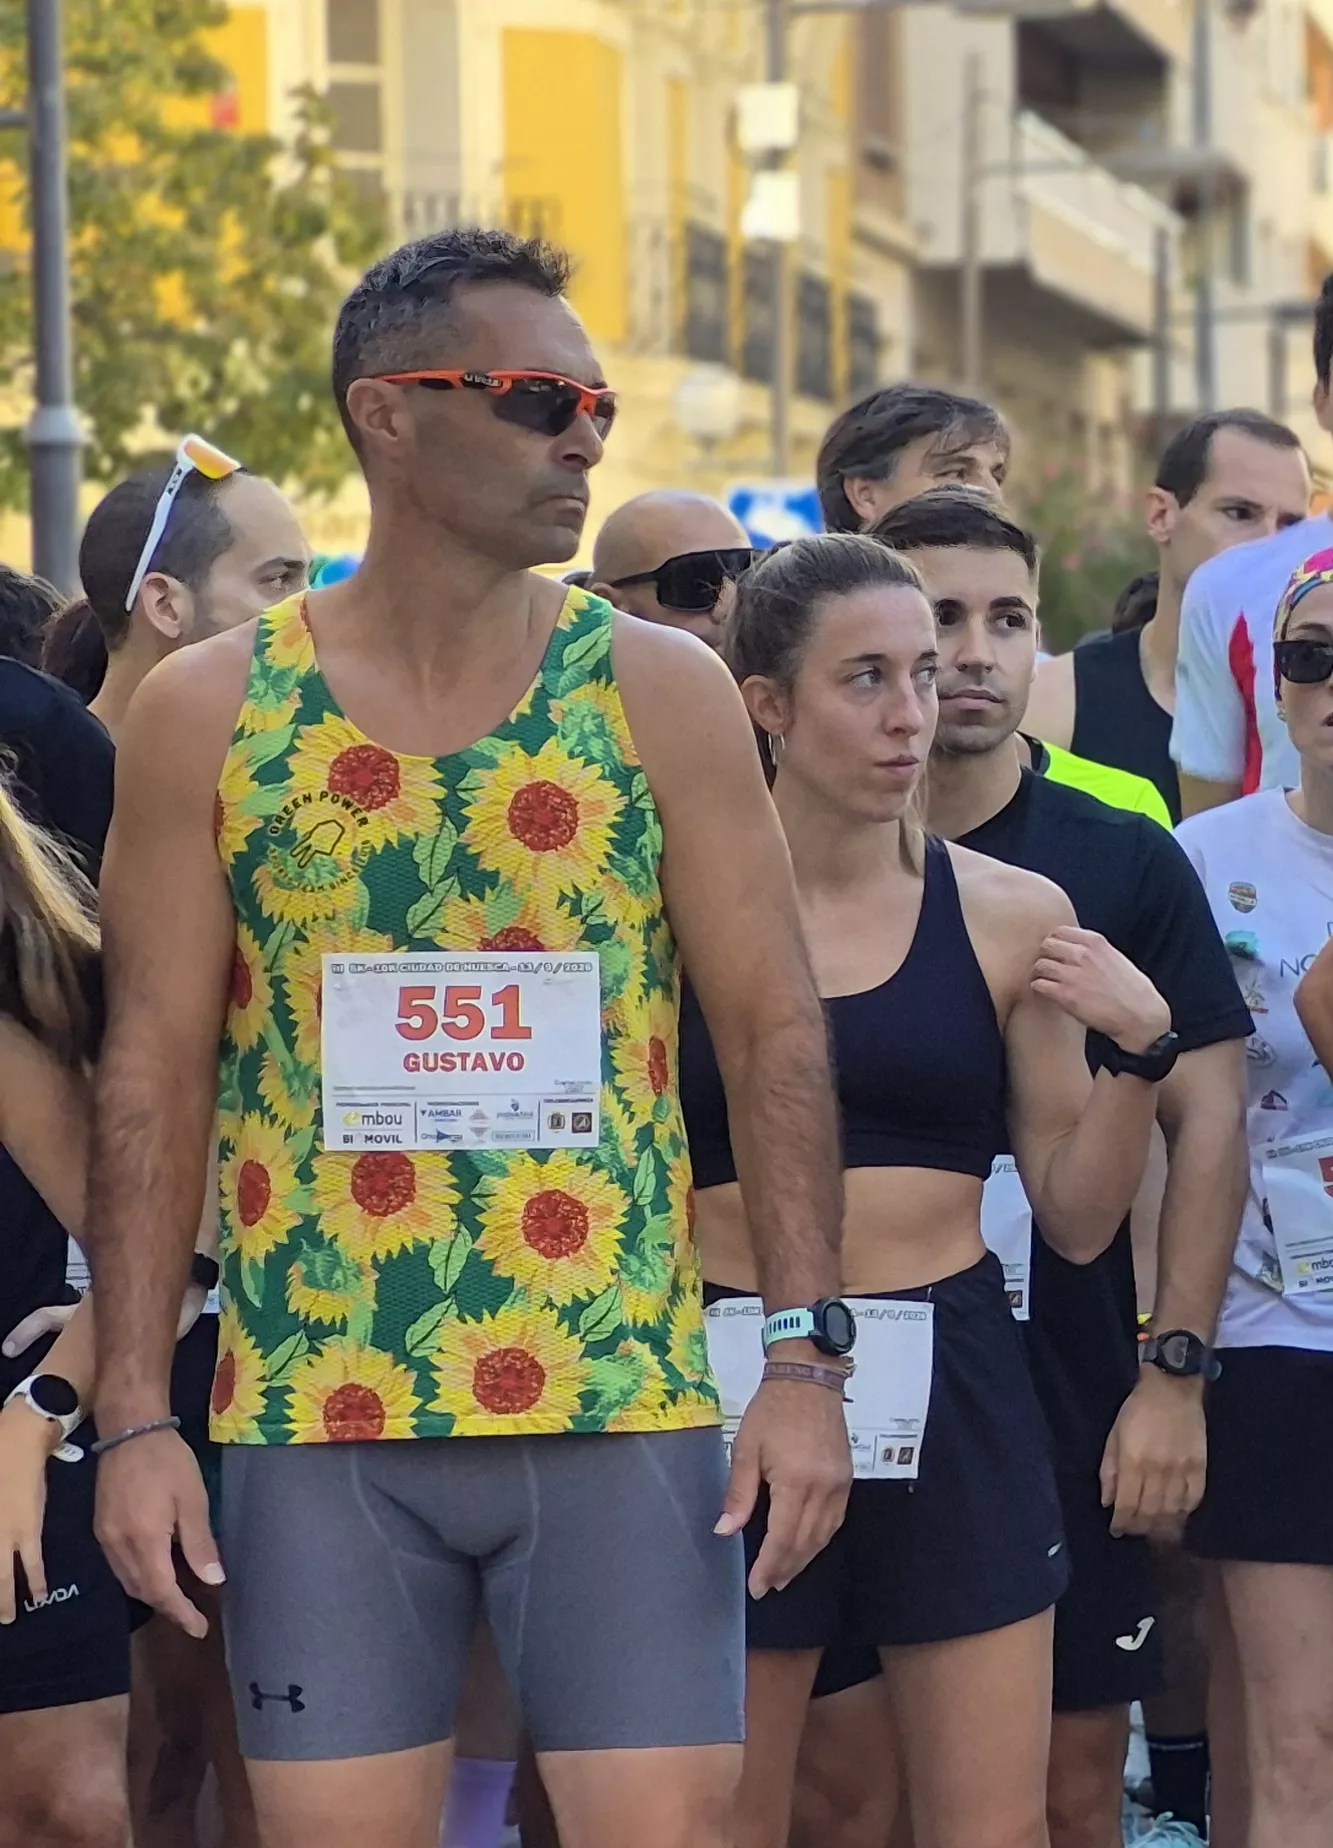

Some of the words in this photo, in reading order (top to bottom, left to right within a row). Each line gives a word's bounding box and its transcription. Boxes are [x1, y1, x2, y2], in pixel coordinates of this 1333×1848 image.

[320, 790, 369, 828] POWER
[395, 984, 533, 1041] 551
[403, 1052, 526, 1073] GUSTAVO
